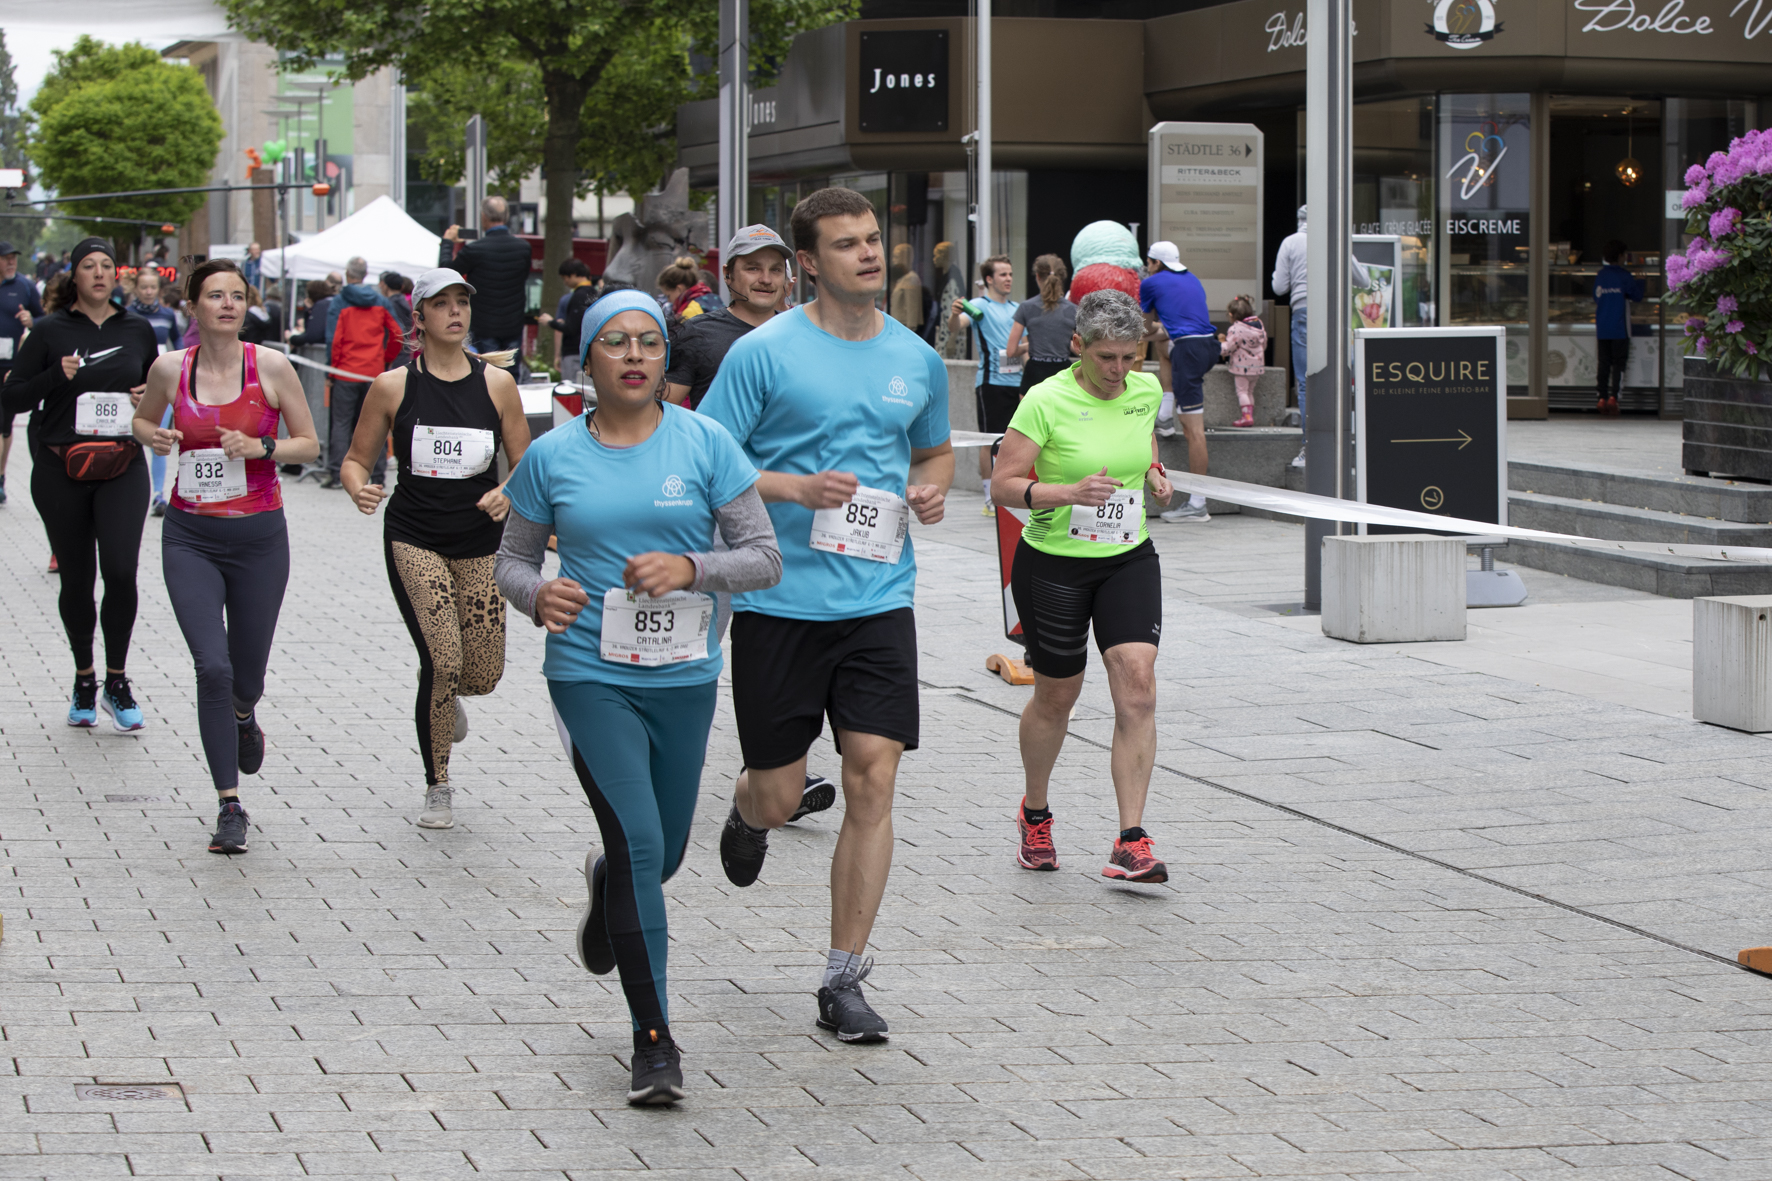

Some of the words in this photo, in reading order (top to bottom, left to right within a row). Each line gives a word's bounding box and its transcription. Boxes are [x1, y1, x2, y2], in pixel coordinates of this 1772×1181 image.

[1574, 0, 1714, 34] Dolce
[1265, 10, 1307, 53] Dolc
[870, 68, 935, 93] Jones
[747, 93, 776, 133] Jones
[1167, 142, 1223, 156] STÄDTLE
[1228, 145, 1241, 156] 36
[1177, 168, 1241, 176] RITTER&BECK
[1360, 222, 1380, 235] GLACE
[1446, 219, 1521, 234] EISCREME
[1373, 361, 1490, 383] ESQUIRE
[1389, 387, 1415, 395] KLEINE
[95, 403, 118, 417] 868
[433, 440, 463, 456] 804
[433, 457, 462, 465] STEPHANIE
[195, 462, 224, 479] 832
[845, 503, 879, 528] 852
[1096, 503, 1124, 520] 878
[849, 528, 870, 538] JAKUB
[635, 610, 675, 633] 853
[637, 636, 672, 645] CATALINA
